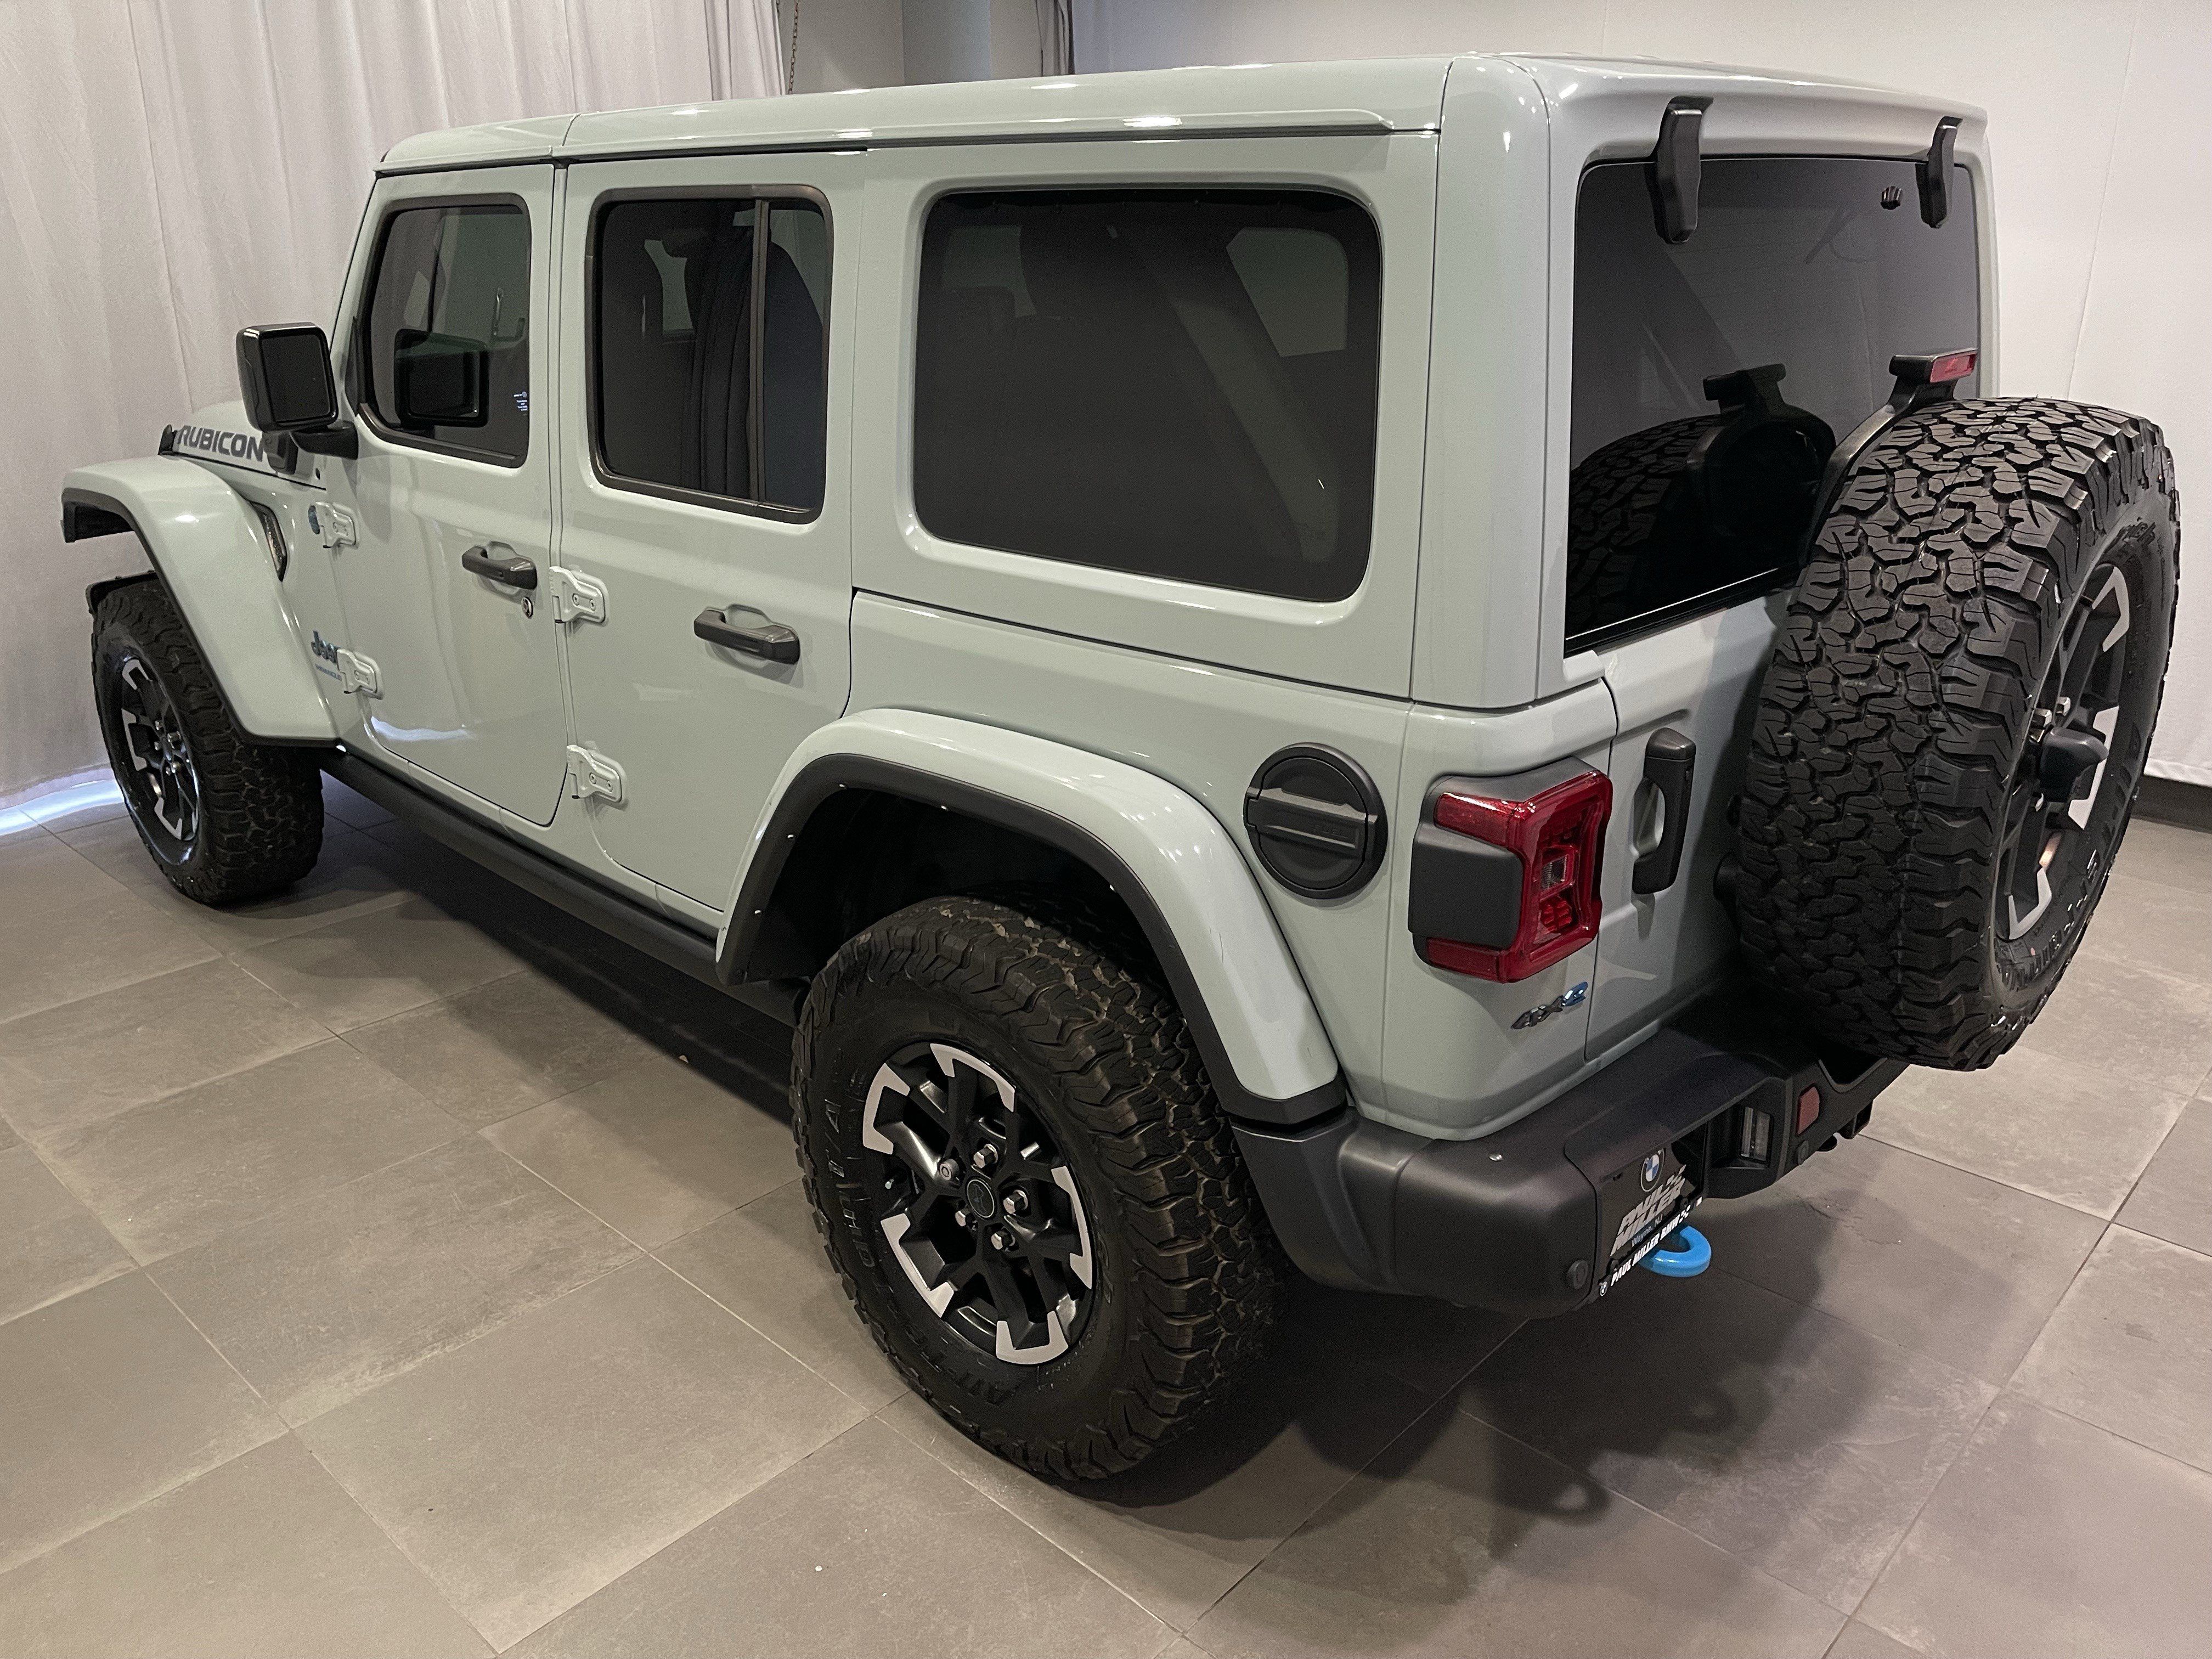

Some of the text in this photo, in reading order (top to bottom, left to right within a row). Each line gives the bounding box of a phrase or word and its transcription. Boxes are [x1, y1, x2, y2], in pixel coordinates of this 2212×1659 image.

[177, 425, 264, 462] RUBICON
[311, 630, 341, 664] Jee
[1609, 1177, 1685, 1257] MILLER
[1617, 1184, 1669, 1235] PAUL
[1611, 1259, 1631, 1286] PAUL
[1632, 1233, 1660, 1266] MILLER
